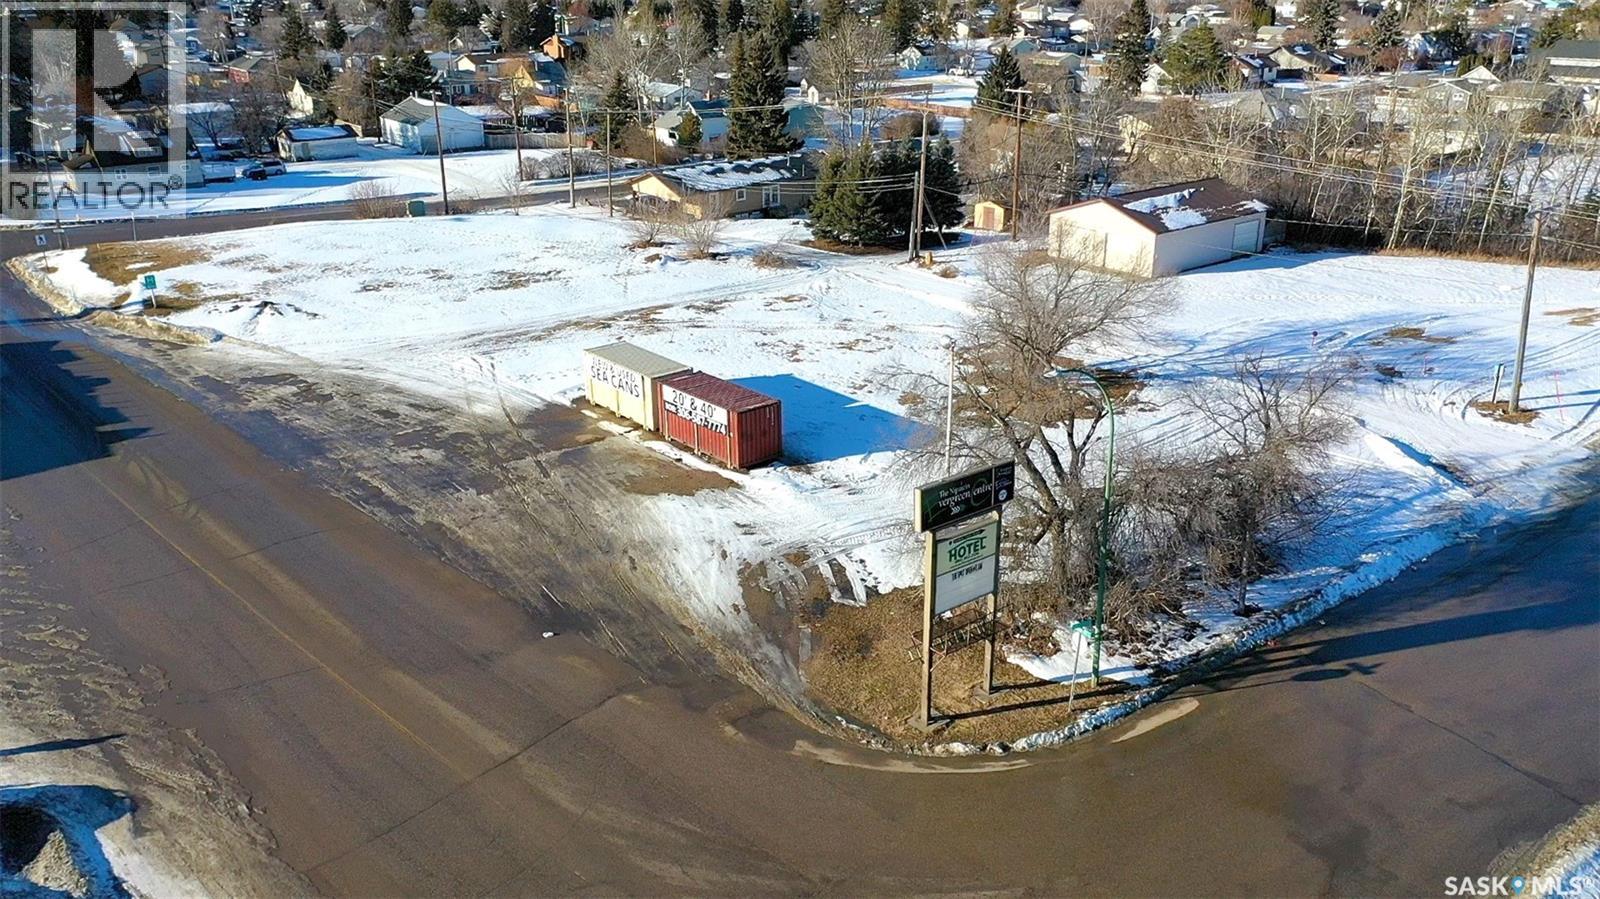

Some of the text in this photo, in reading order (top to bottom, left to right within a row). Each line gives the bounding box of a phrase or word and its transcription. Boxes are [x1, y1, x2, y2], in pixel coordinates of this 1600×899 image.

[591, 365, 640, 398] SEA CANS
[618, 369, 636, 383] USED
[672, 390, 687, 406] 20'
[690, 397, 698, 411] &
[701, 402, 717, 418] 40'
[948, 537, 987, 562] HOTEL
